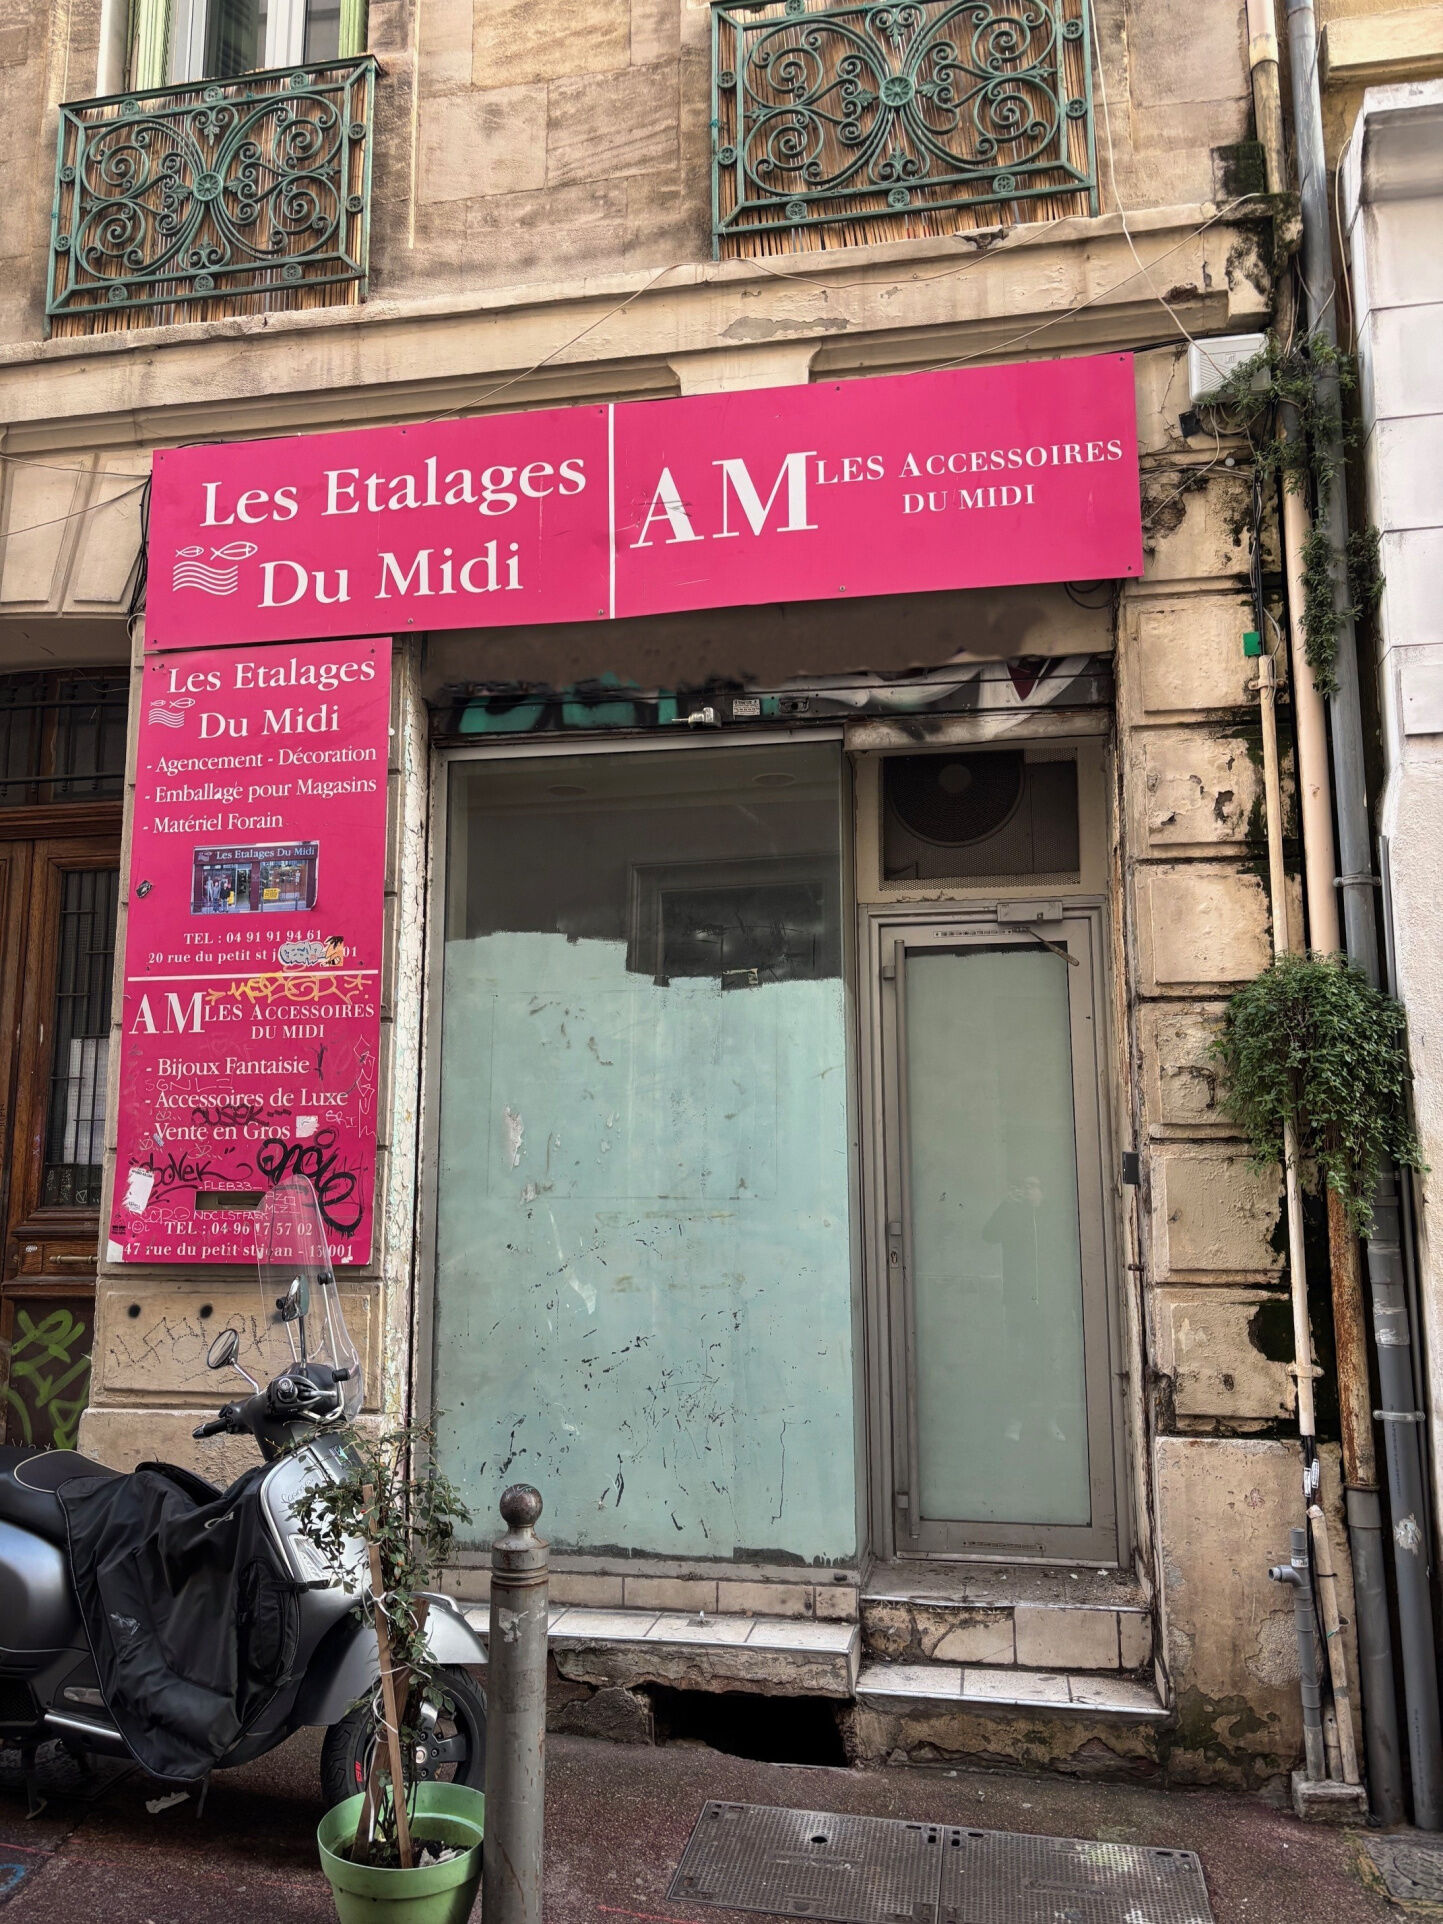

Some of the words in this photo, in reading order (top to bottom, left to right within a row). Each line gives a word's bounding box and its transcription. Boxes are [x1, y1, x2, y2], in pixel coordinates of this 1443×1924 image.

[815, 455, 885, 485] LES
[899, 439, 1123, 478] ACCESSOIRES
[200, 481, 298, 527] Les
[321, 455, 586, 516] Etalages
[902, 491, 947, 515] DU
[959, 484, 1036, 509] MIDI
[258, 560, 351, 608] Du
[375, 539, 524, 600] Midi
[167, 667, 221, 694] Les
[233, 657, 376, 692] Etalages
[198, 712, 249, 739] Du
[261, 703, 340, 735] Midi
[155, 752, 263, 777] Agencement
[279, 745, 377, 766] Décoration
[155, 782, 244, 805] Emballage
[248, 783, 292, 803] pour
[296, 776, 377, 799] Magasins
[152, 813, 222, 834] Matériel
[227, 812, 283, 830] Forain
[216, 851, 232, 860] Les
[235, 849, 274, 860] Etalages
[277, 848, 291, 857] Du
[294, 847, 314, 856] Midi
[184, 932, 214, 945] TEL
[226, 931, 242, 945] 04
[246, 931, 260, 944] 91
[266, 930, 281, 943] 91
[286, 930, 302, 942] 94
[307, 929, 321, 941] 61
[148, 952, 163, 964] 20
[167, 953, 193, 964] rue
[195, 950, 214, 963] du
[218, 948, 251, 965] petit
[255, 949, 268, 961] st
[204, 1004, 243, 1022] LES
[250, 1003, 375, 1021] ACCESSOIRES
[250, 1026, 277, 1040] DU
[282, 1024, 325, 1039] MIDI
[157, 1058, 220, 1080] Bijoux
[225, 1055, 310, 1075] Fantaisie
[155, 1091, 264, 1108] Accessoires
[269, 1090, 294, 1107] de
[300, 1088, 348, 1106] Luxe
[154, 1123, 207, 1140] Vente
[213, 1125, 237, 1139] en
[243, 1122, 291, 1140] Gros
[164, 1222, 197, 1235] TEL
[212, 1222, 228, 1235] 04
[234, 1222, 250, 1235] 96
[276, 1223, 292, 1235] 57
[297, 1223, 312, 1235] 02
[124, 1243, 140, 1255] 47
[146, 1246, 171, 1256] rue
[177, 1243, 196, 1256] du
[202, 1243, 238, 1259] petit
